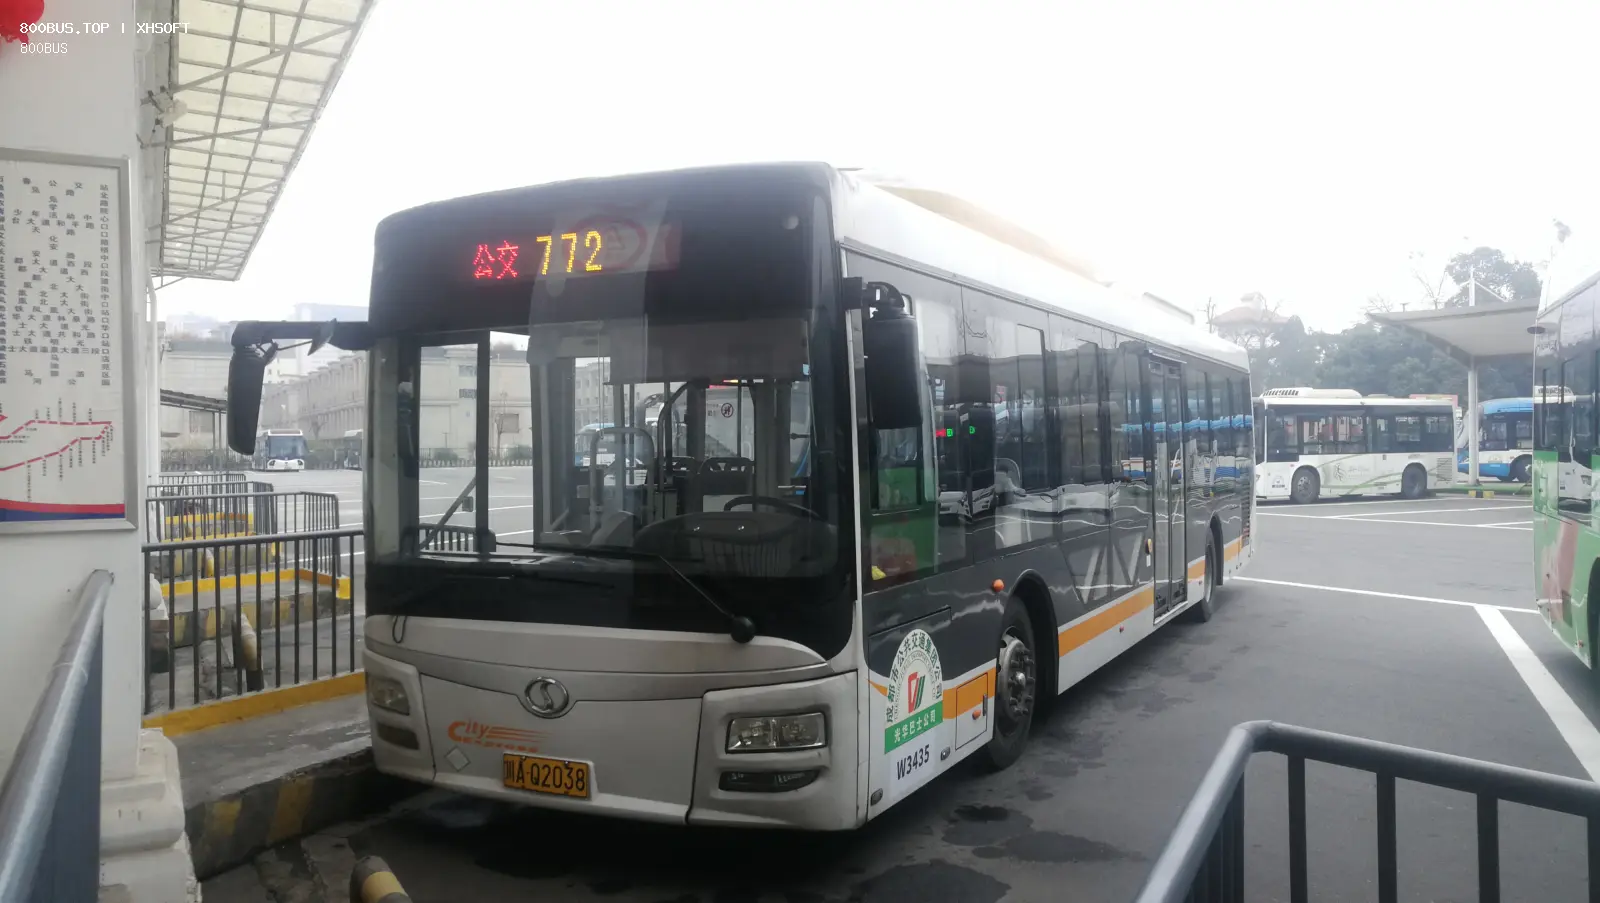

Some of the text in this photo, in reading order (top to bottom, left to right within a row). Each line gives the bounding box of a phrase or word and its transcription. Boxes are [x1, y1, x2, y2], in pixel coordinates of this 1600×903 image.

[473, 231, 602, 279] 公交 772
[886, 631, 943, 723] 成都市公共交通集团公司
[893, 709, 936, 744] 光华巴士公司
[896, 744, 930, 781] W3435
